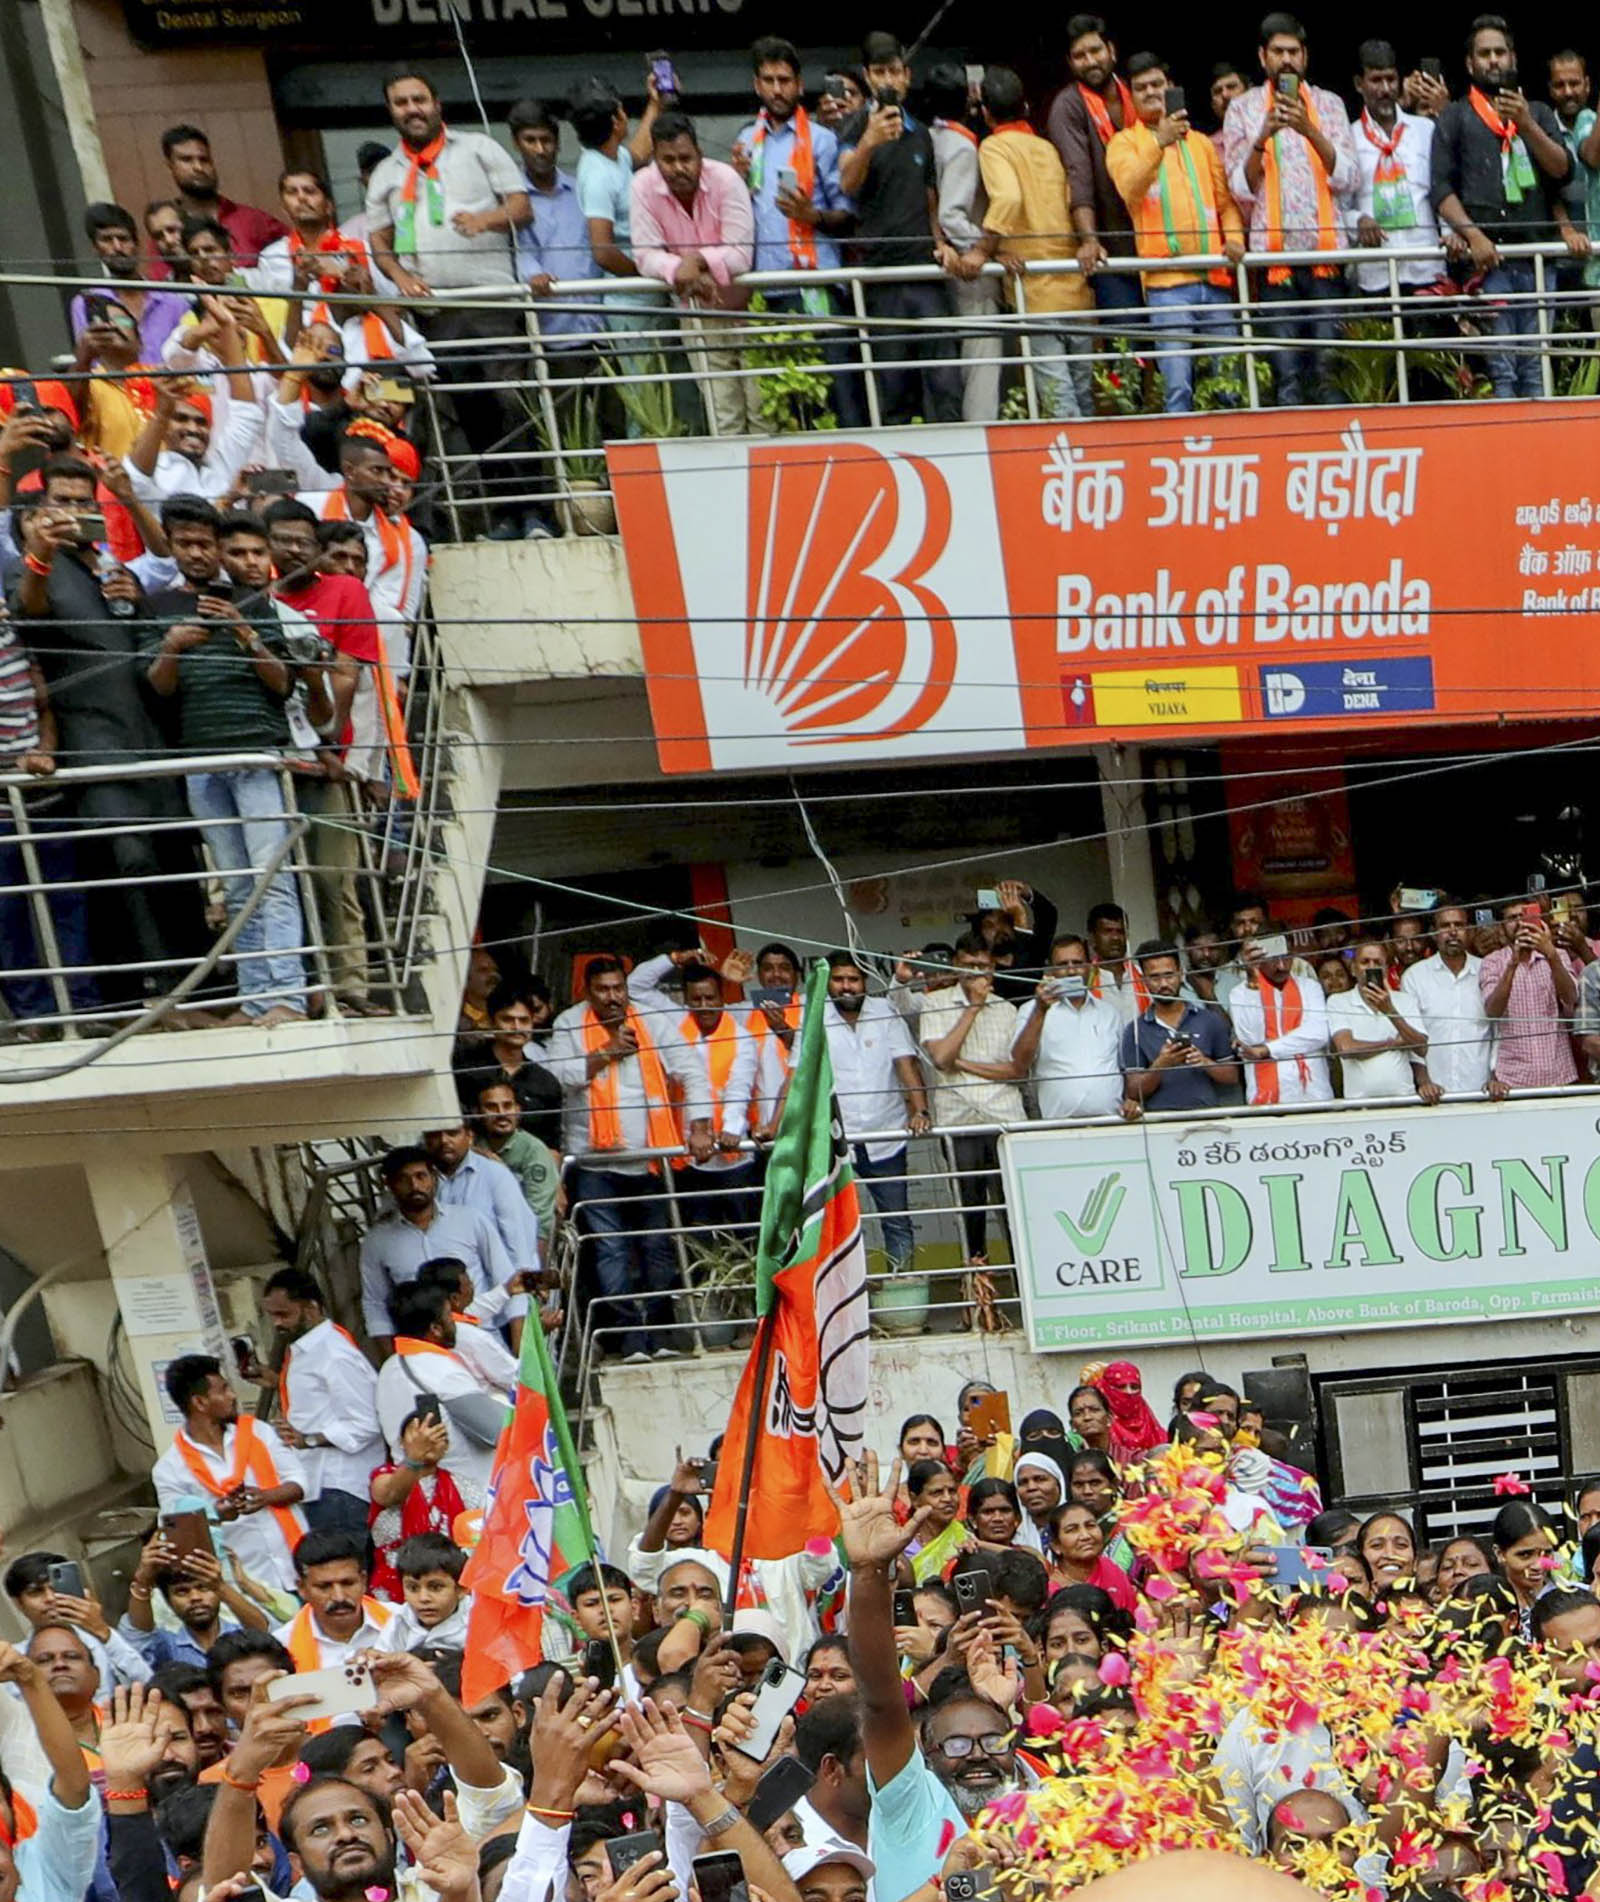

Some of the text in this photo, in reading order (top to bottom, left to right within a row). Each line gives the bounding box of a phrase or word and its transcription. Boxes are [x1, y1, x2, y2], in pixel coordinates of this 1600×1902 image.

[1041, 431, 1125, 533] बैंक
[1286, 418, 1423, 536] बड़ौदा
[1055, 560, 1431, 655] Bank of Baroda
[1522, 589, 1567, 617] Bank
[1570, 586, 1592, 616] of
[1341, 667, 1377, 690] देना
[1147, 699, 1189, 717] VIJAYA
[1343, 690, 1381, 711] DENA
[1204, 1140, 1242, 1165] కేర్
[1055, 1257, 1143, 1289] CARE
[1105, 1319, 1170, 1336] Srikant
[1171, 1312, 1225, 1332] Dental
[1228, 1308, 1296, 1330] Hospital,
[1308, 1307, 1354, 1322] Above
[1359, 1303, 1402, 1319] Bank
[1405, 1299, 1420, 1315] of
[1424, 1296, 1485, 1315] Baroda,
[1488, 1294, 1527, 1312] Opp.
